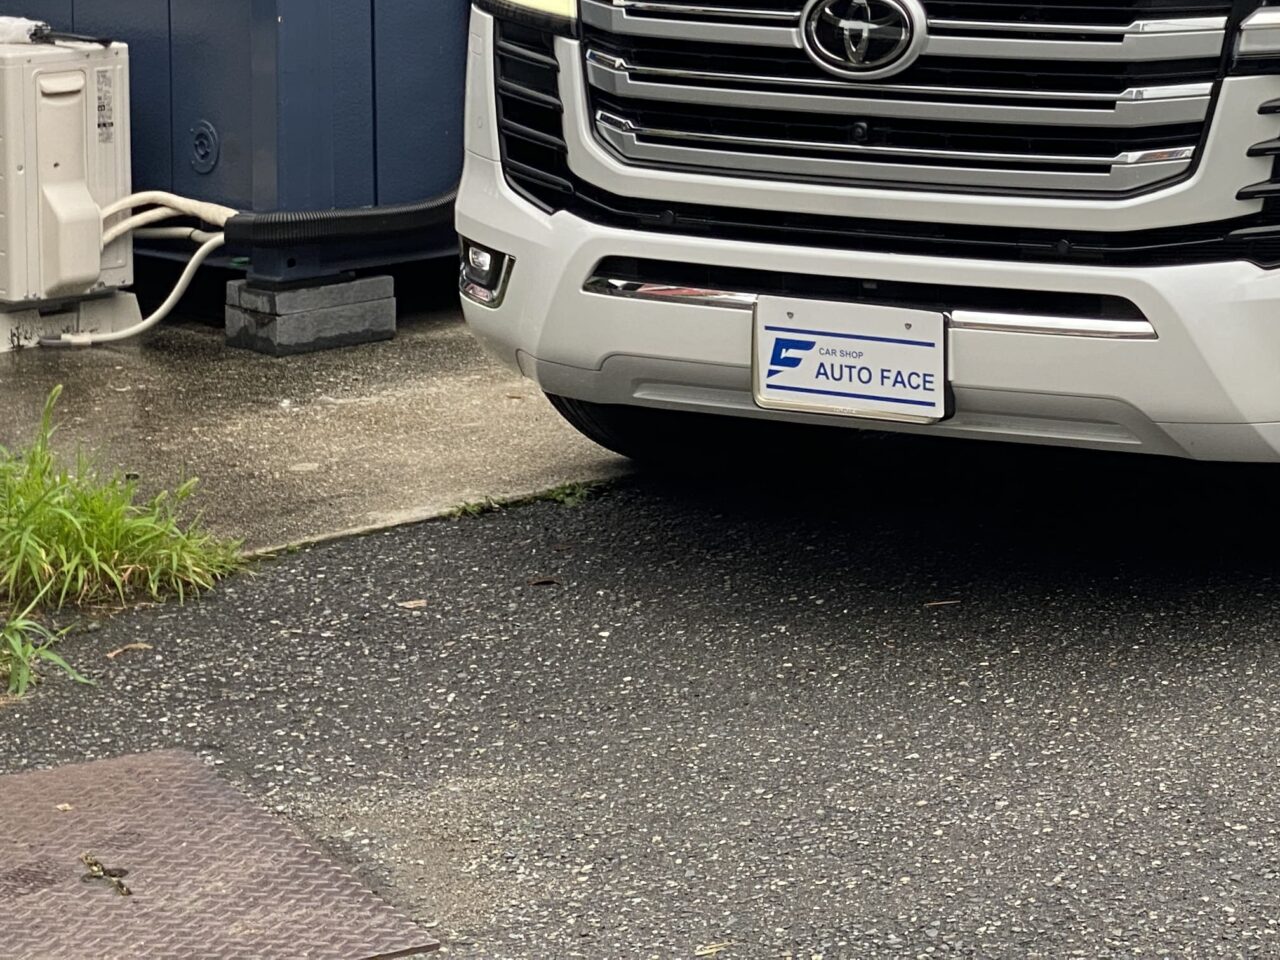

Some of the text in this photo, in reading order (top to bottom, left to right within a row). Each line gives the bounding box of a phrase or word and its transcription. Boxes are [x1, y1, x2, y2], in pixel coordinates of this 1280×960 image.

[819, 348, 863, 359] CAR SHOP
[815, 362, 935, 391] AUTO FACE
